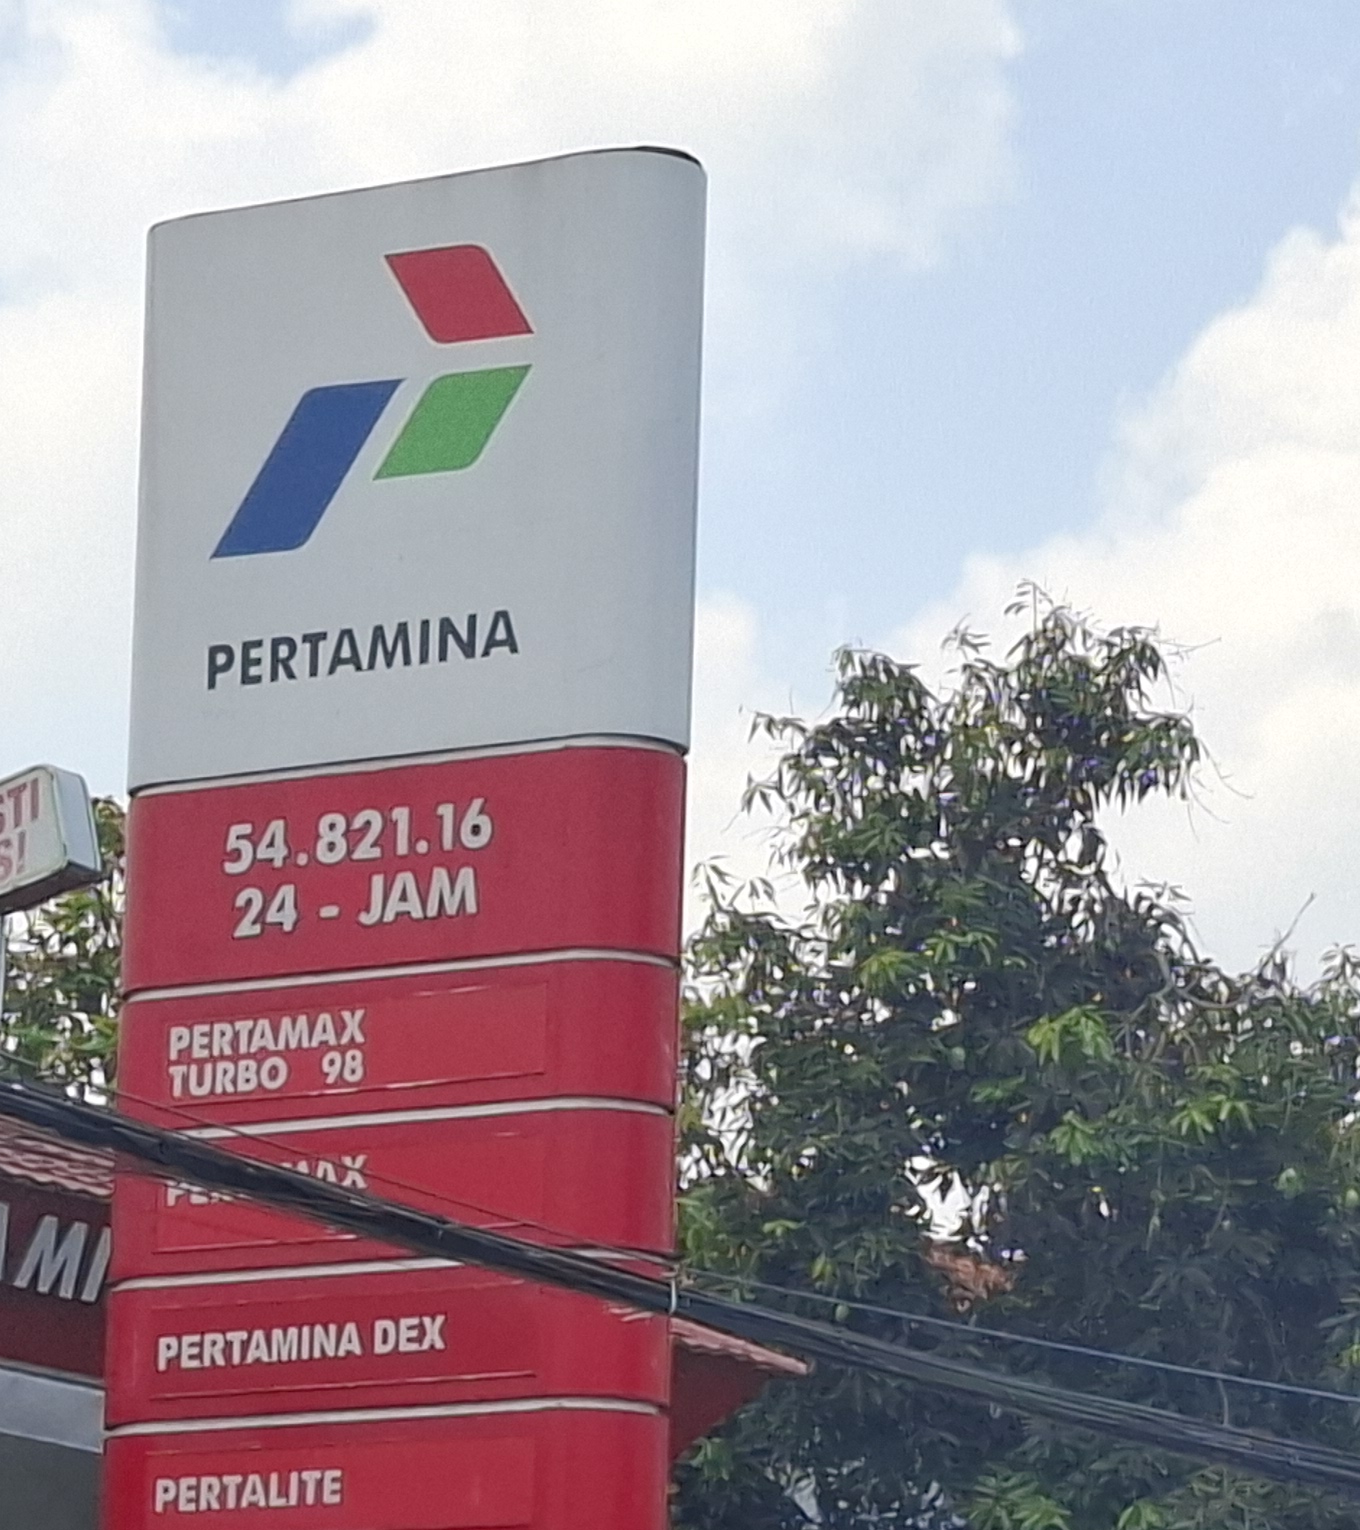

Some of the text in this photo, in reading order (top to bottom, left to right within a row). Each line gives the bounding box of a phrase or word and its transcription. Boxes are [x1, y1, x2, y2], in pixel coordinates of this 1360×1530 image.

[206, 609, 519, 691] PERTAMINA
[223, 797, 493, 875] 54.821.16
[233, 866, 478, 939] 24 - JAM
[169, 1008, 366, 1061] PERTAMAX
[168, 1049, 365, 1098] TURBO 98
[157, 1314, 446, 1372] PERTAMINA DEX
[154, 1470, 343, 1513] PERTALITE
